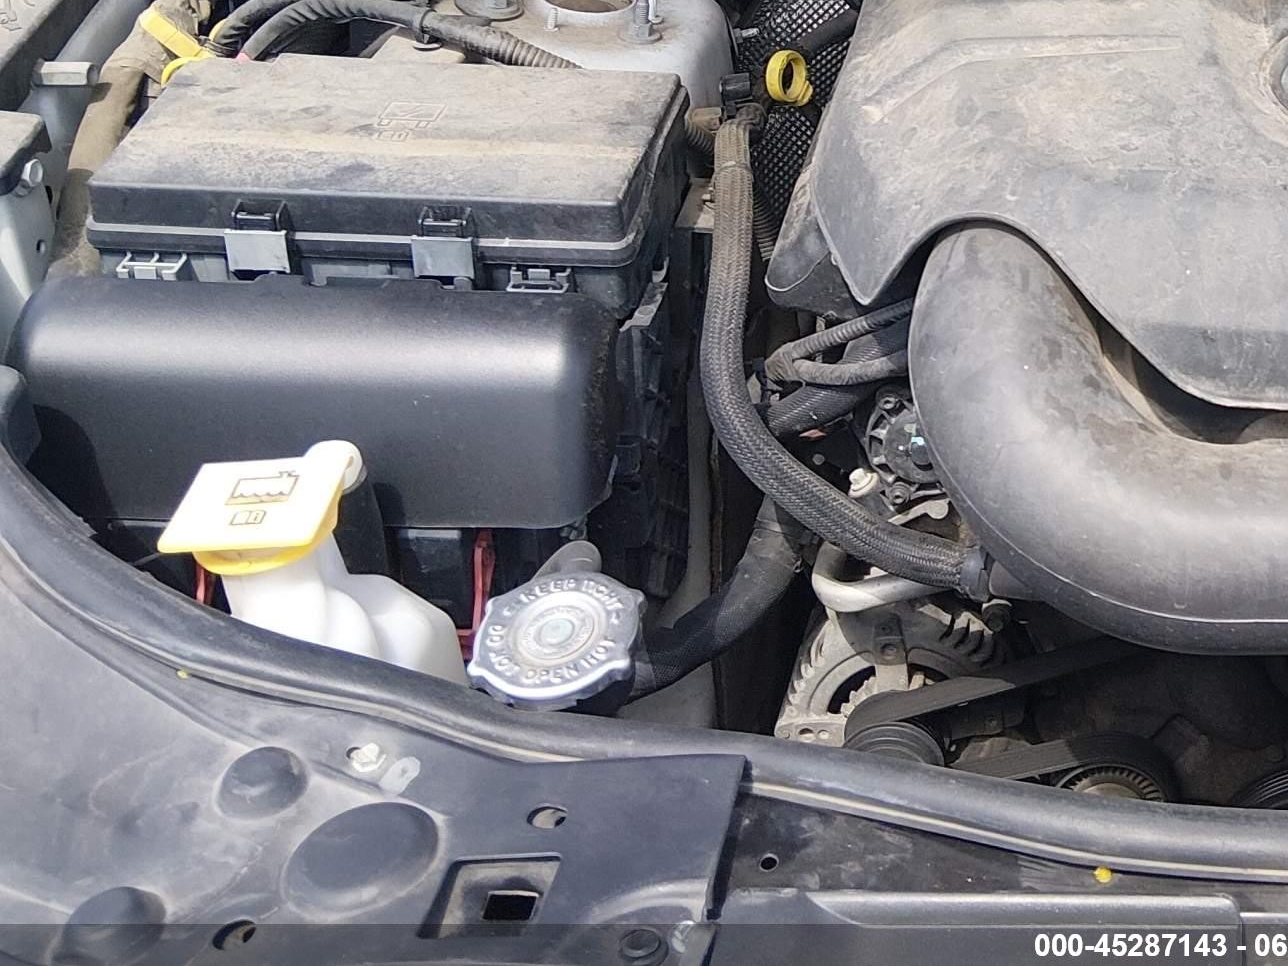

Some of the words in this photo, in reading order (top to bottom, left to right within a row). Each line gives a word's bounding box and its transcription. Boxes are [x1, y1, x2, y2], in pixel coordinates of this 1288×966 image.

[519, 578, 577, 603] KEEP
[486, 624, 507, 647] DO
[488, 650, 521, 677] NOT
[580, 636, 617, 670] HOT
[521, 667, 579, 685] OPEN
